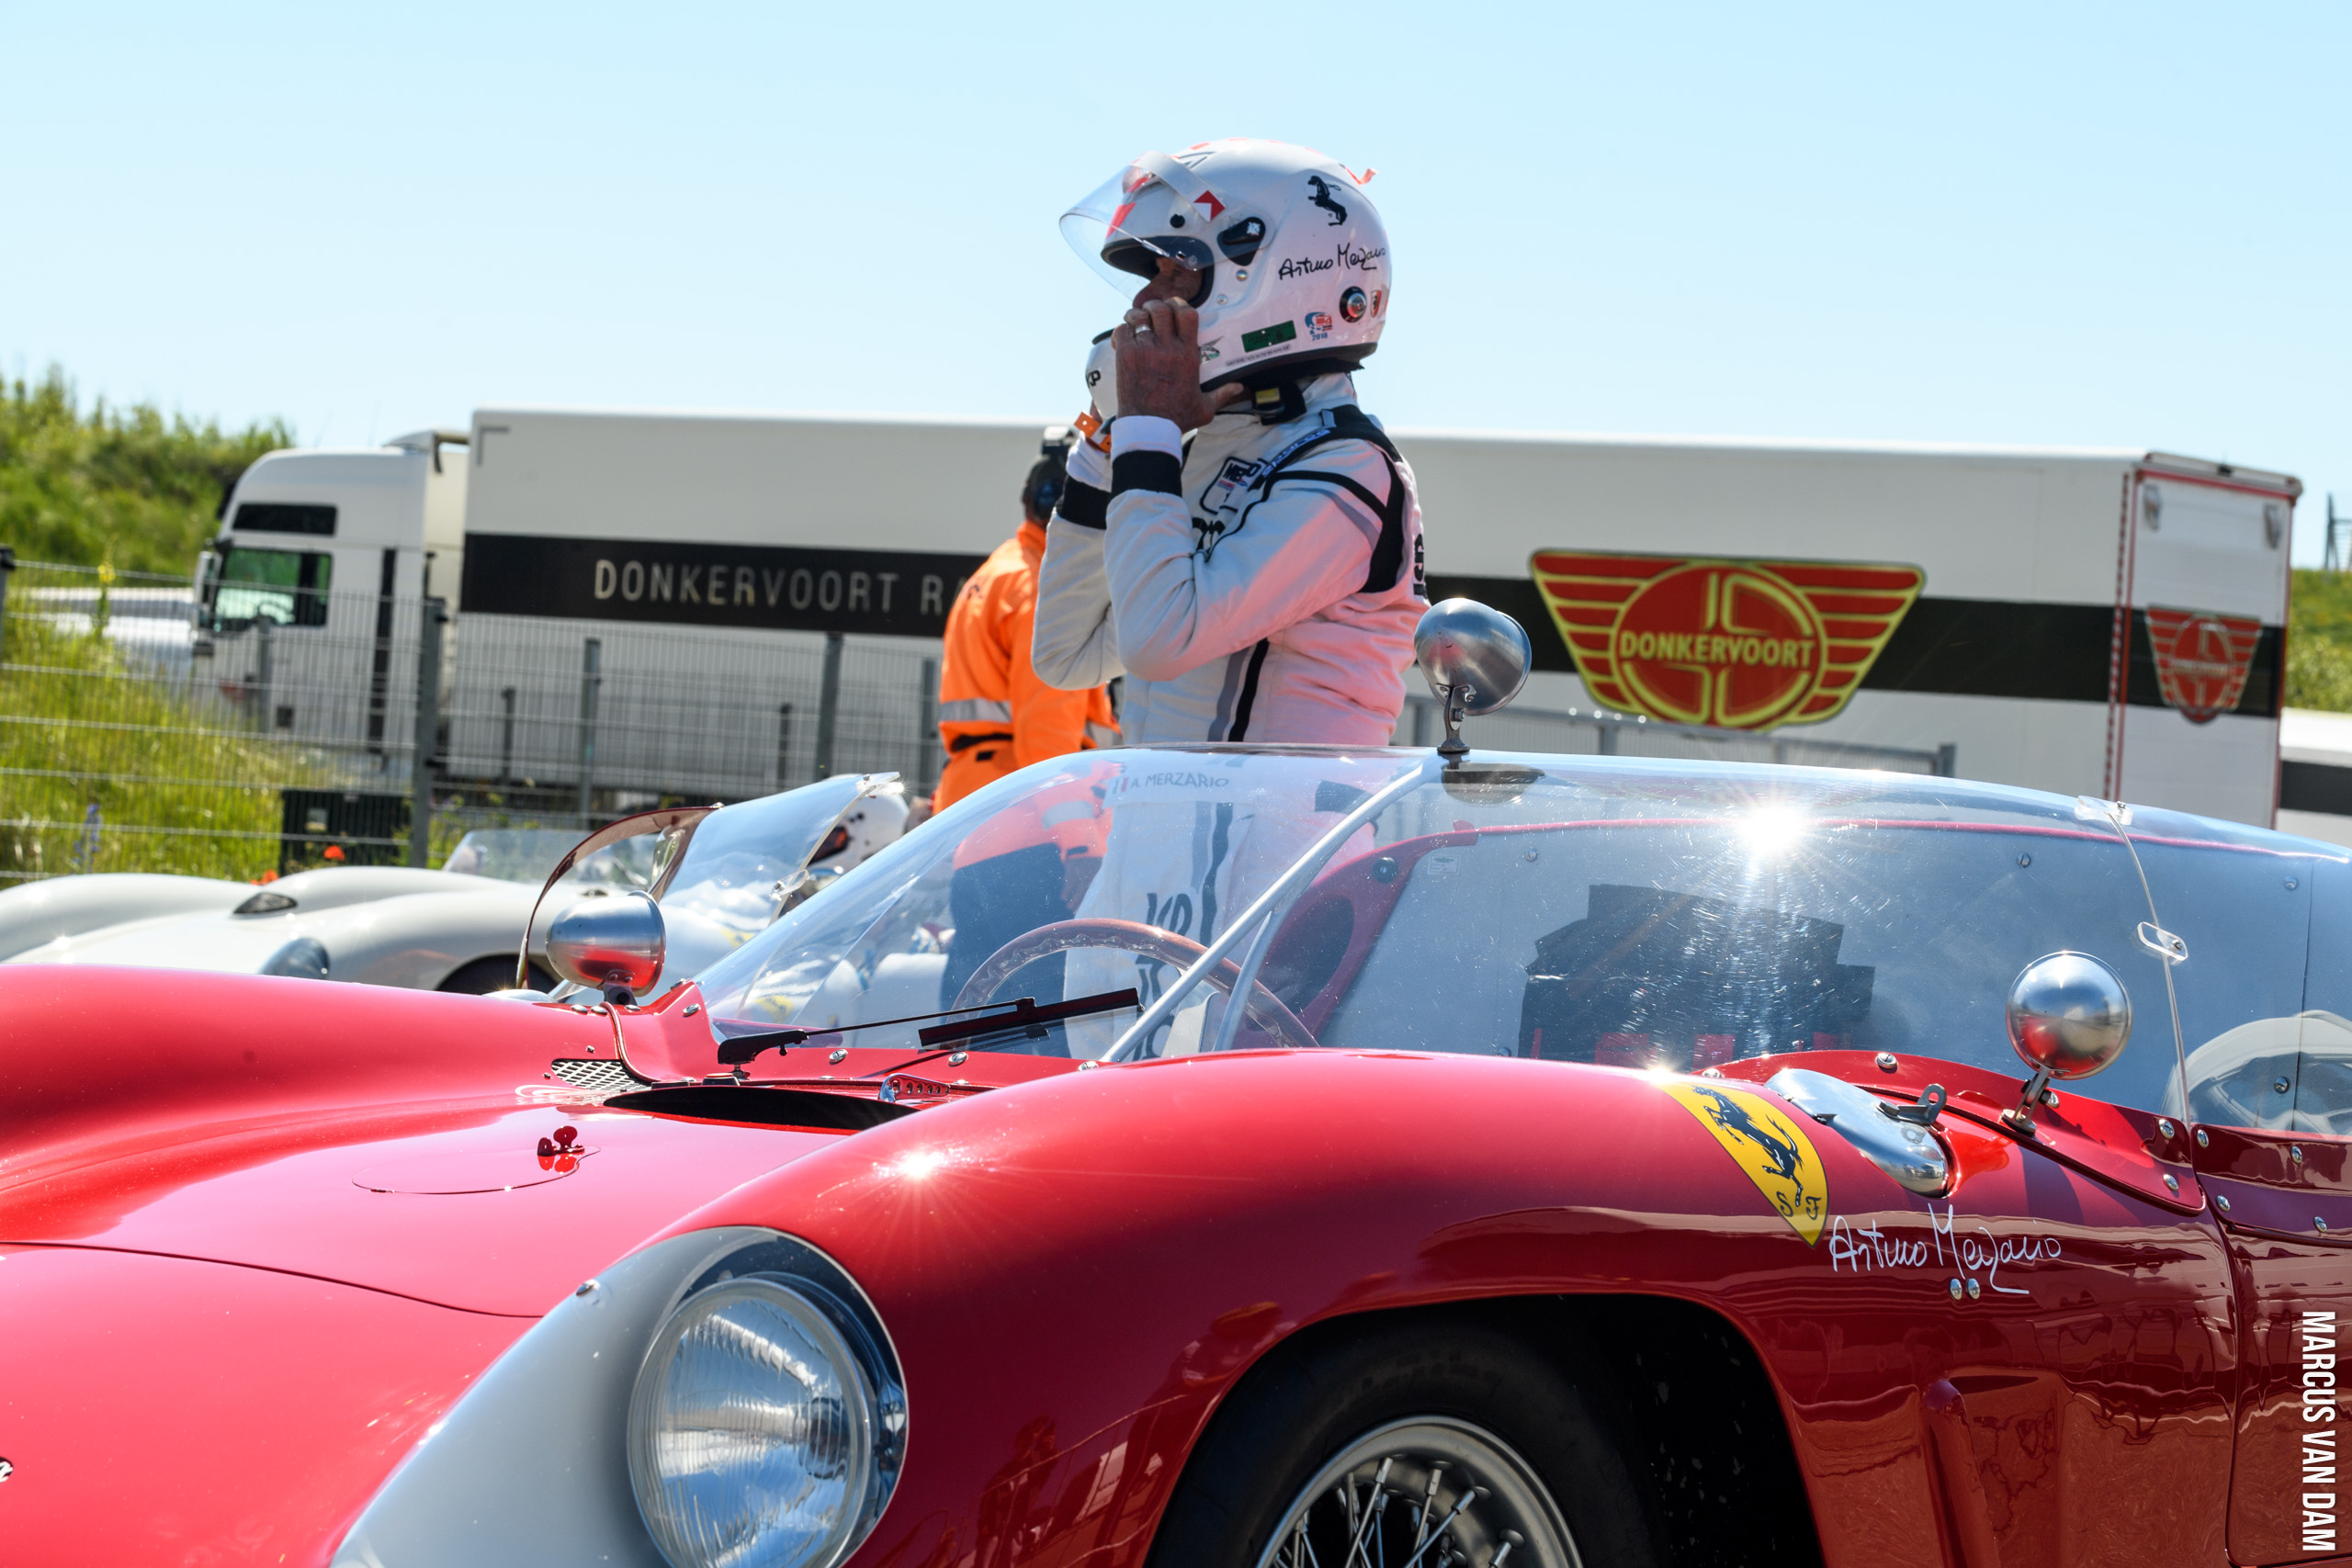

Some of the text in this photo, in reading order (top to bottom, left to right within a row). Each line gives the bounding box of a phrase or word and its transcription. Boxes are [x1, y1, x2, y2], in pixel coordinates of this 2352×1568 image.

[594, 558, 899, 614] DONKERVOORT
[1619, 630, 1815, 669] DONKERVOORT
[1145, 772, 1229, 788] MERZARIO
